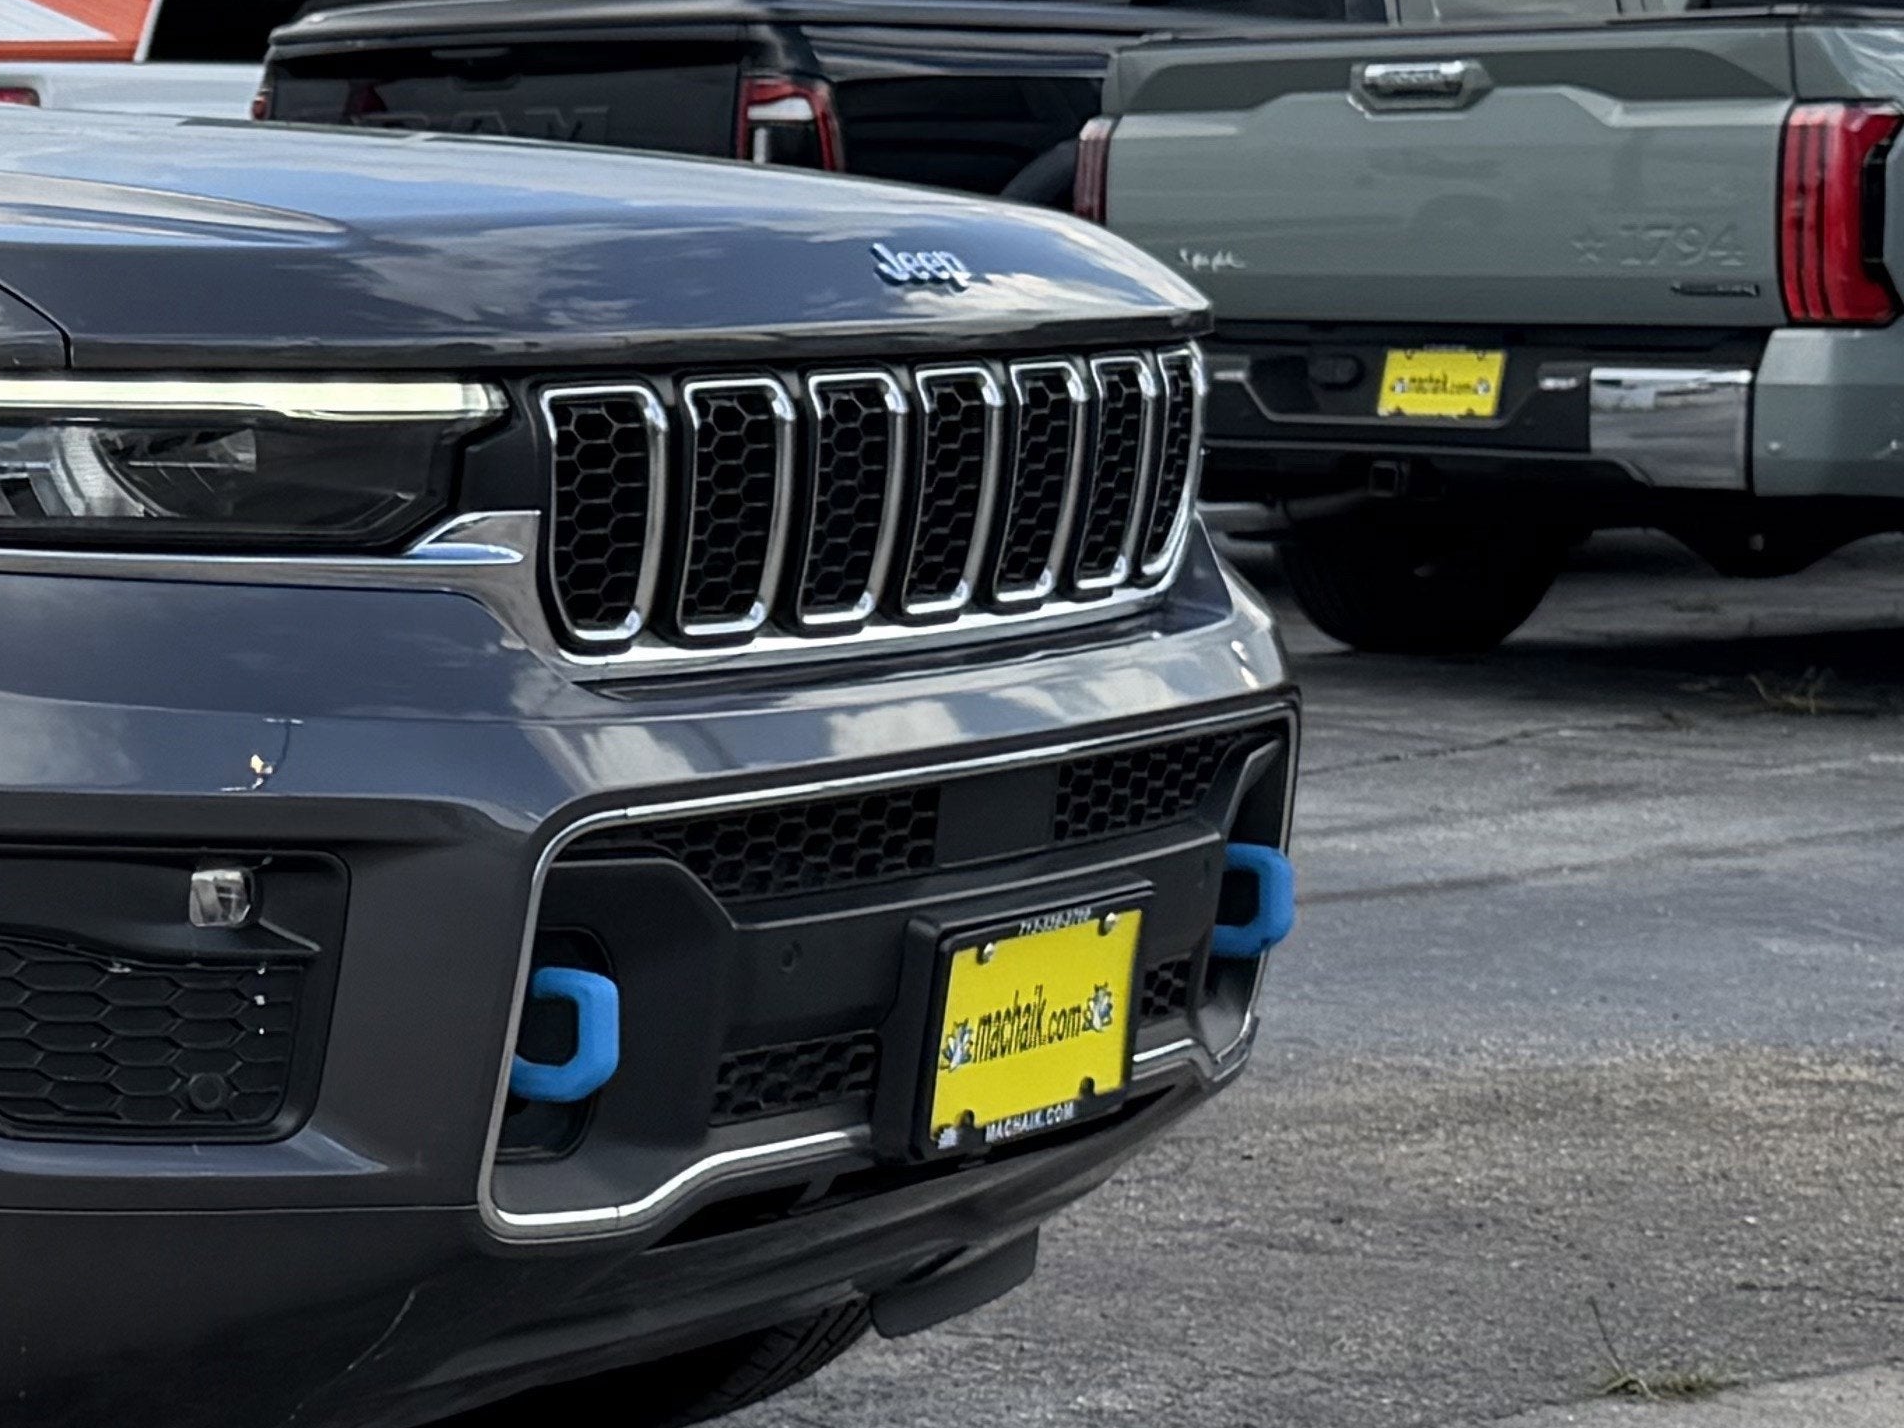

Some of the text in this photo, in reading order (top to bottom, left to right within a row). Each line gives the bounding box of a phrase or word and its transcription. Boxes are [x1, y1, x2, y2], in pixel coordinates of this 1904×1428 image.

[870, 242, 971, 288] Jeep
[1619, 222, 1746, 268] 1794
[972, 984, 1082, 1063] machaik.com
